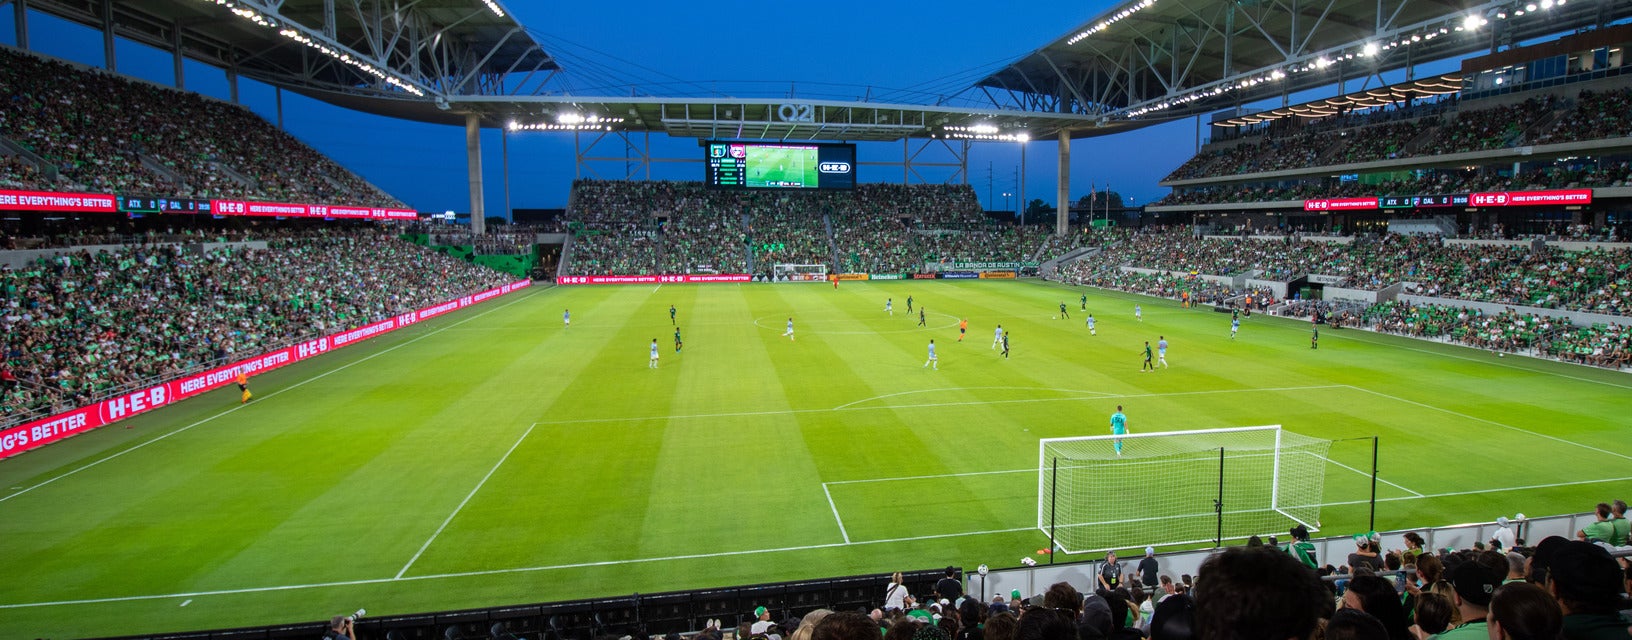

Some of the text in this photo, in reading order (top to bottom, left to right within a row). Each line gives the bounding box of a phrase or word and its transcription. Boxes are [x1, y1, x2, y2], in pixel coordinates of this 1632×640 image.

[778, 103, 811, 122] Q2
[19, 195, 81, 207] EVERYTHING'S
[82, 198, 112, 207] BETTER
[129, 200, 141, 208] ATX
[180, 373, 205, 394] HERE
[263, 352, 289, 368] BETTER
[31, 413, 87, 442] BETTER
